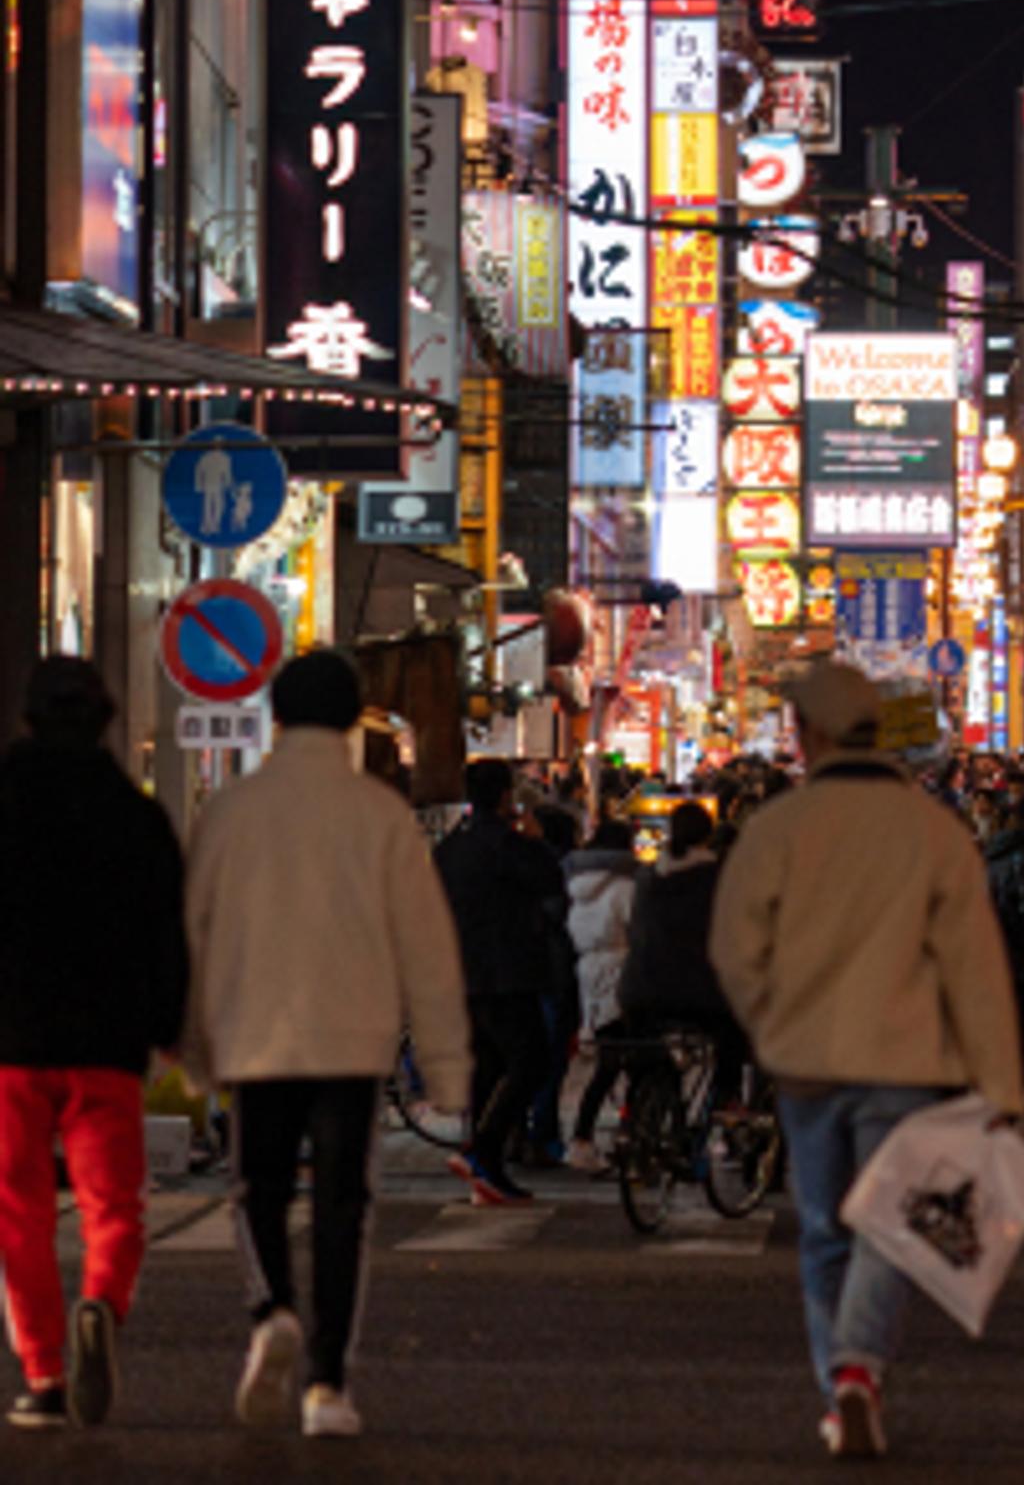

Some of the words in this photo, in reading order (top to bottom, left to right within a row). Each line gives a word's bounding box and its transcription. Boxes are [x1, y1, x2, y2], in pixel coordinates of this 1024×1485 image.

[814, 340, 953, 370] Welcome
[813, 376, 841, 397] to
[846, 373, 950, 398] OSAKA
[727, 358, 798, 626] 大阪王将
